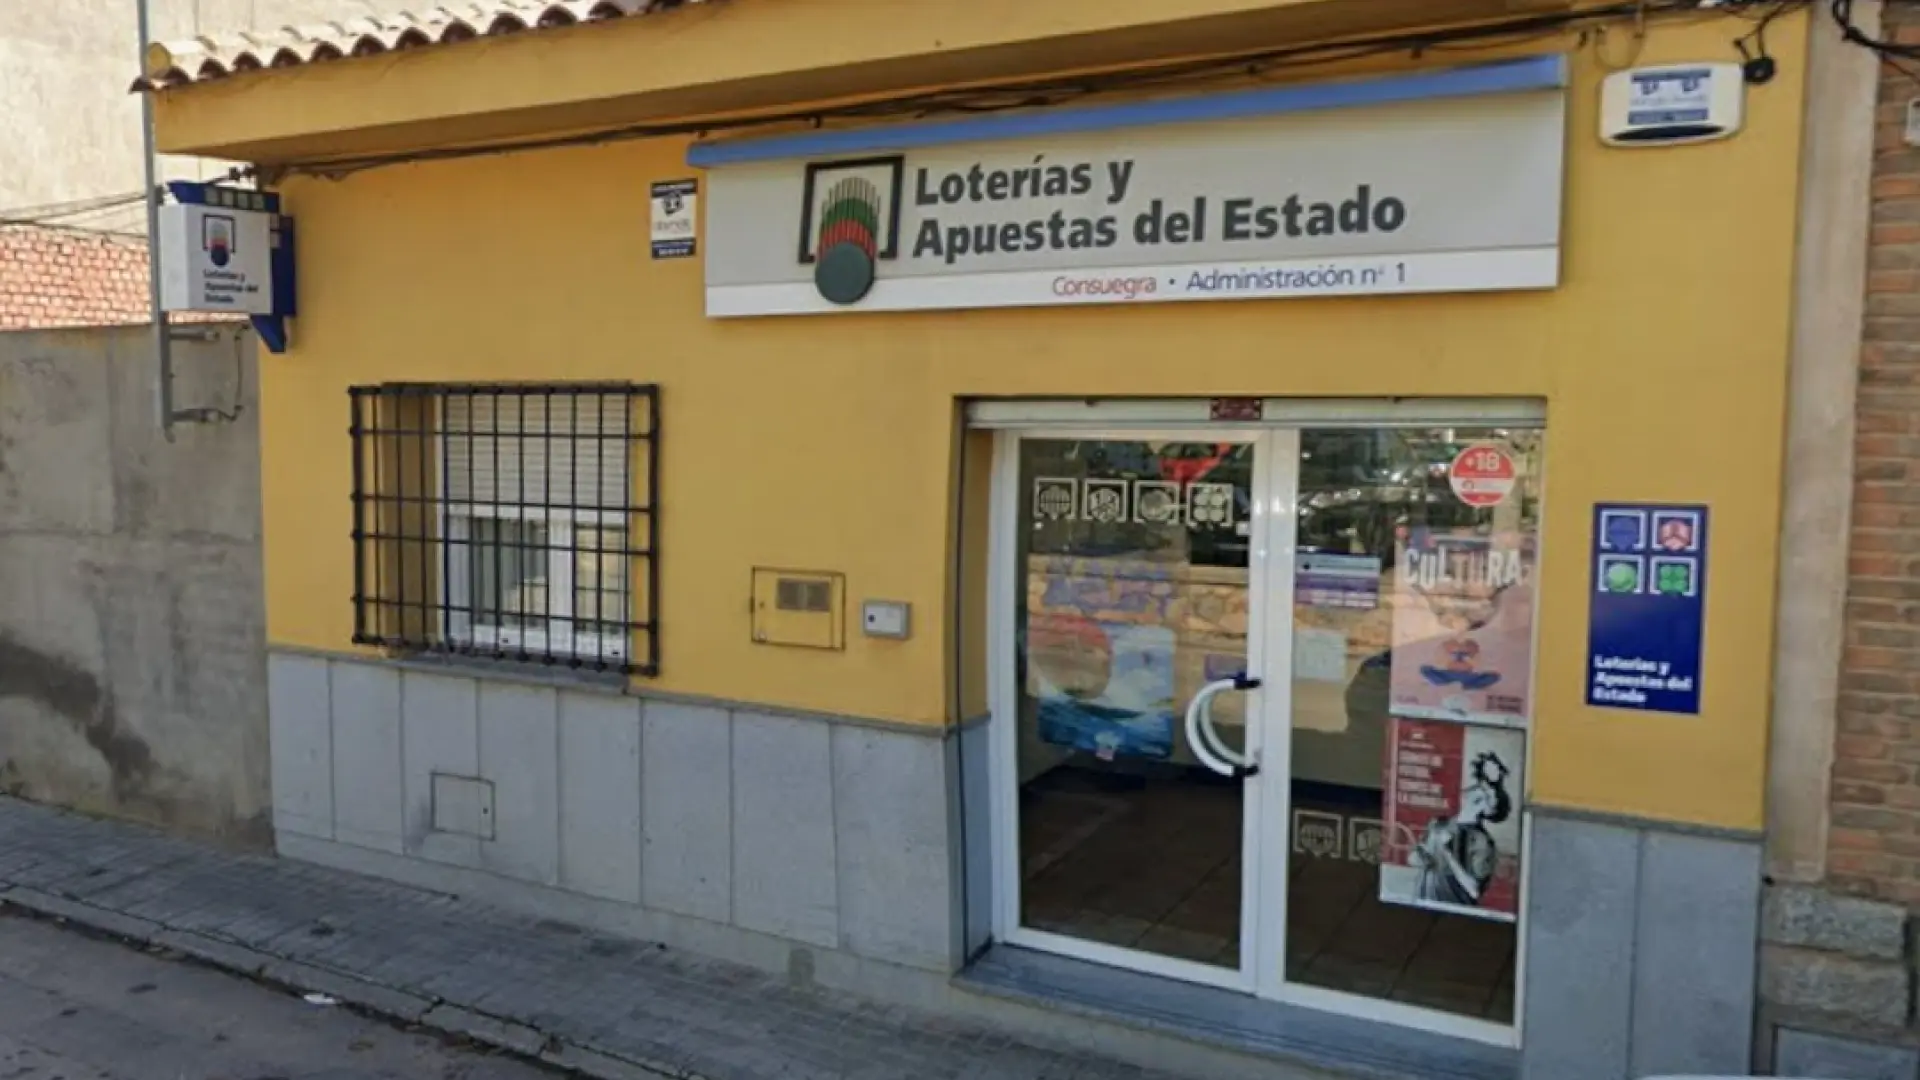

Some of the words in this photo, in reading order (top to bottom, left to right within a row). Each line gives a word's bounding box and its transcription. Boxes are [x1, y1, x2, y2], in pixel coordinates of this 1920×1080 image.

[915, 154, 1092, 206] Loterías
[1107, 159, 1134, 204] y
[912, 209, 1117, 264] Apuestas
[1133, 196, 1206, 244] del
[1222, 184, 1406, 242] Estado
[1052, 275, 1157, 299] Consuegra
[1186, 264, 1354, 291] Administración
[1396, 262, 1406, 282] 1
[1404, 545, 1523, 589] CULTURA
